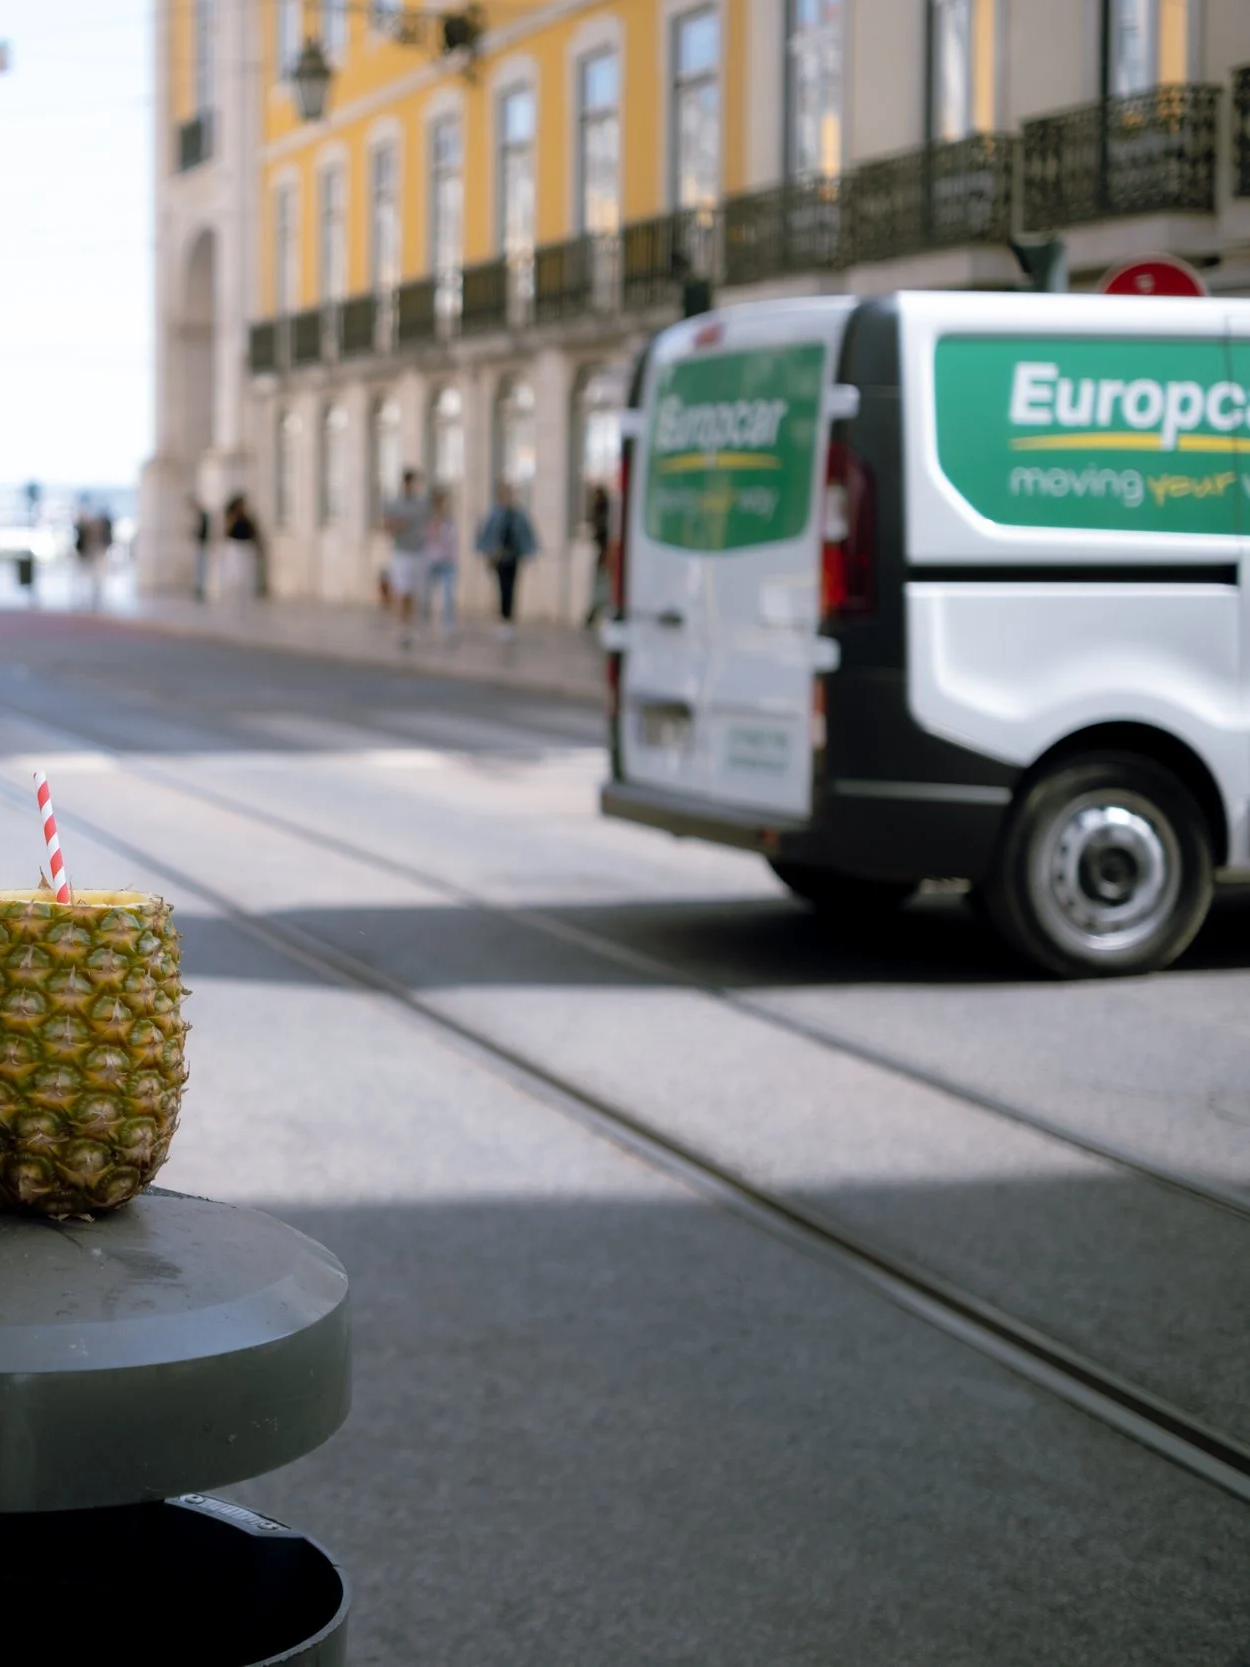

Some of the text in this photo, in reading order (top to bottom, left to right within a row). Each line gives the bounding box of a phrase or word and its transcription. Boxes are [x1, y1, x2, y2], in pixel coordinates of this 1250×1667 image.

[1009, 361, 1250, 452] Europc
[1010, 463, 1144, 508] moving
[1147, 471, 1238, 508] your
